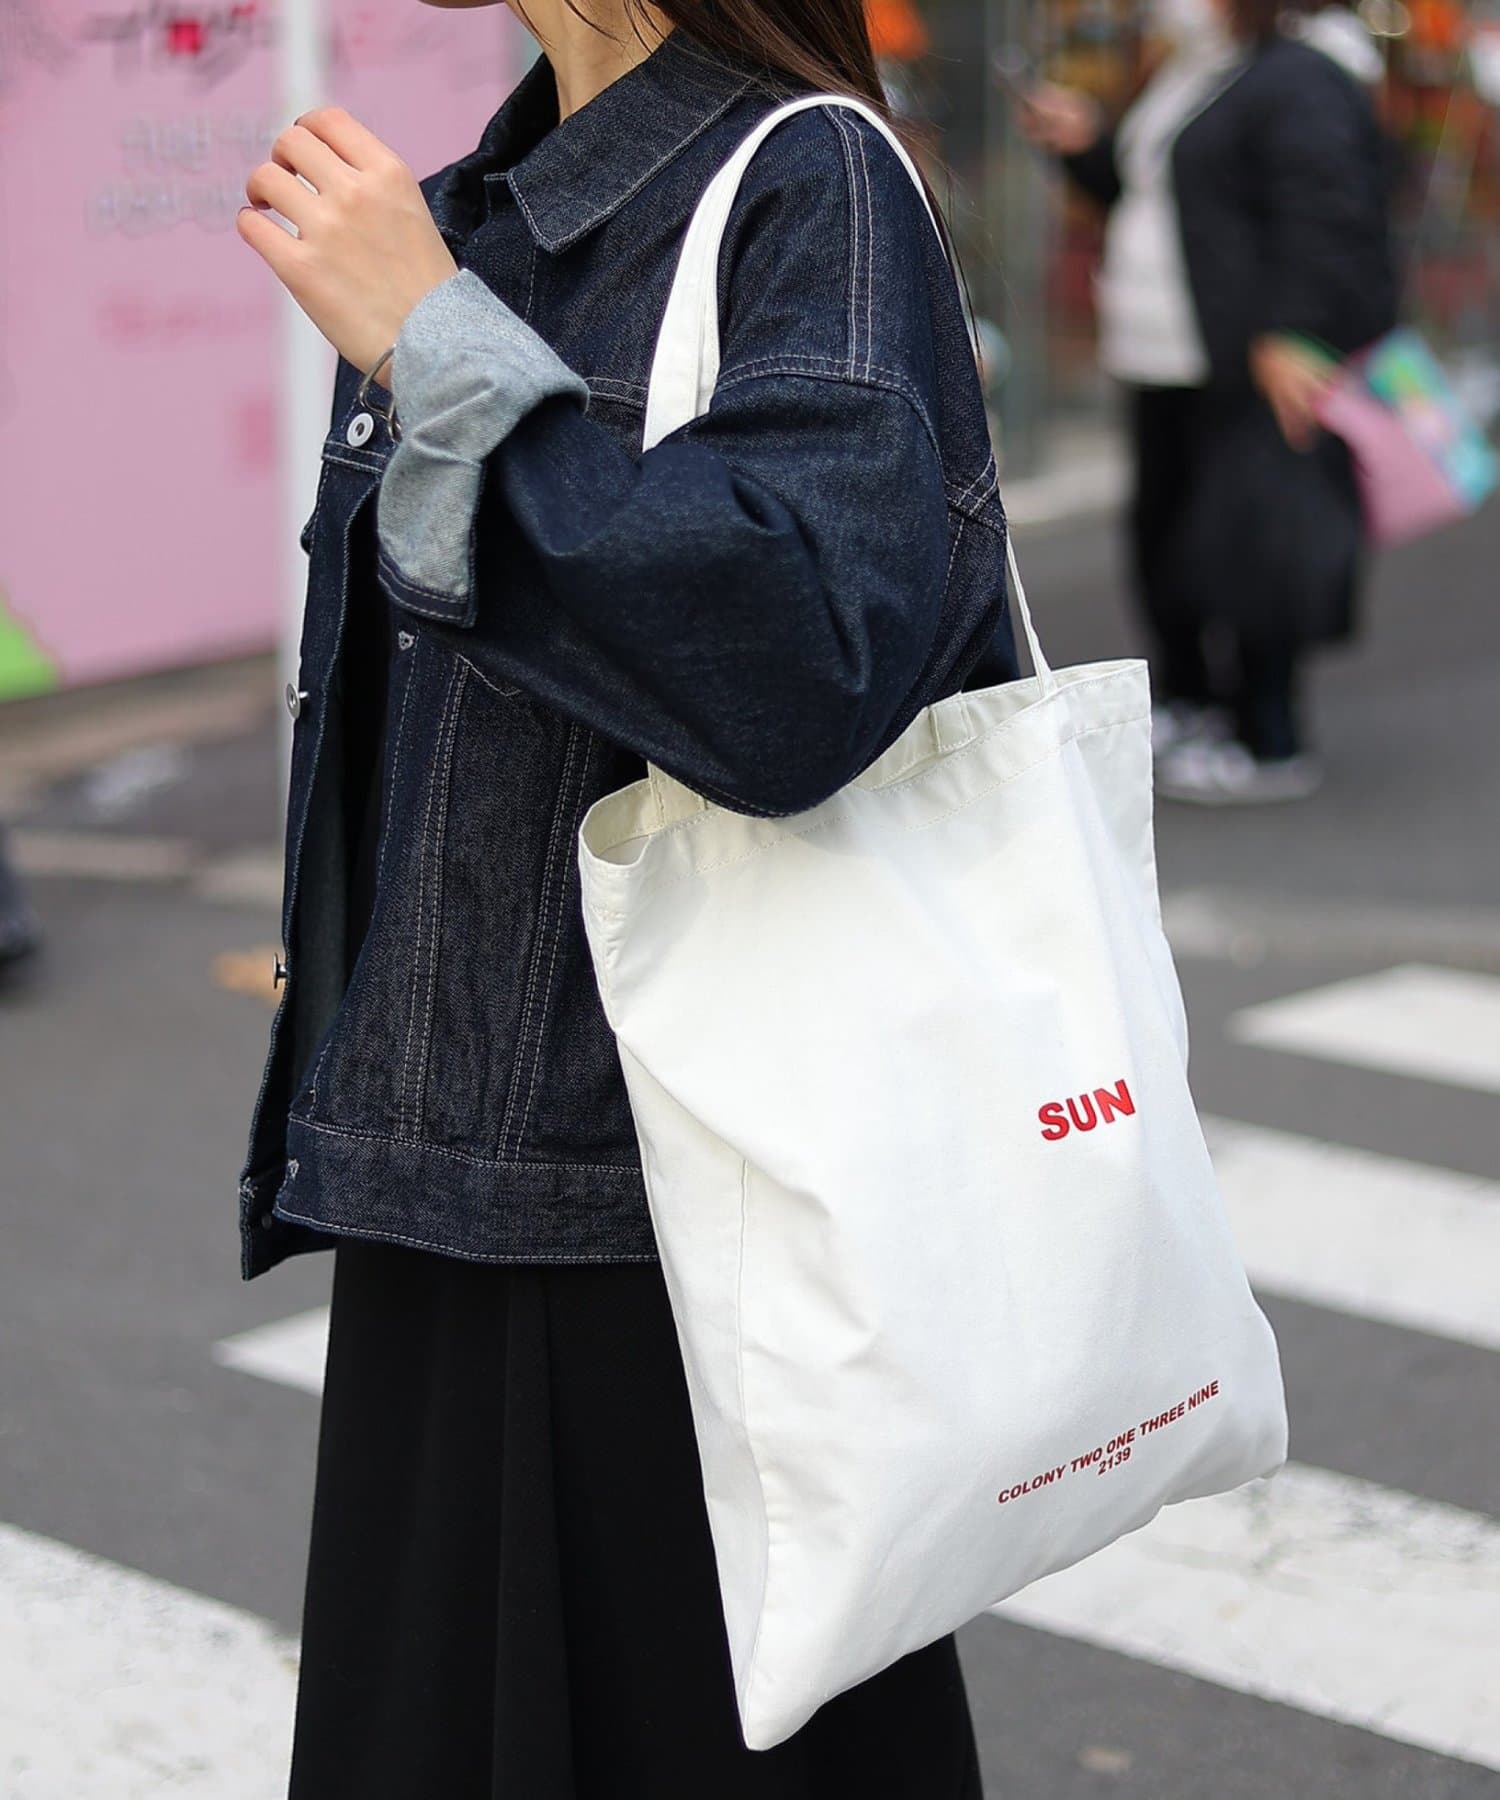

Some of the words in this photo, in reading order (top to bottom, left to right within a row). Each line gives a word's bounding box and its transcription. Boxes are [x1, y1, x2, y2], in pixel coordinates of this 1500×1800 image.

[1038, 1079, 1136, 1141] SUN
[998, 1465, 1066, 1503] COLONY
[1070, 1447, 1102, 1473] TWO
[1106, 1428, 1136, 1454] ONE
[1139, 1402, 1185, 1436] THREE
[1188, 1380, 1219, 1411] NINE
[1097, 1446, 1132, 1476] 2139
